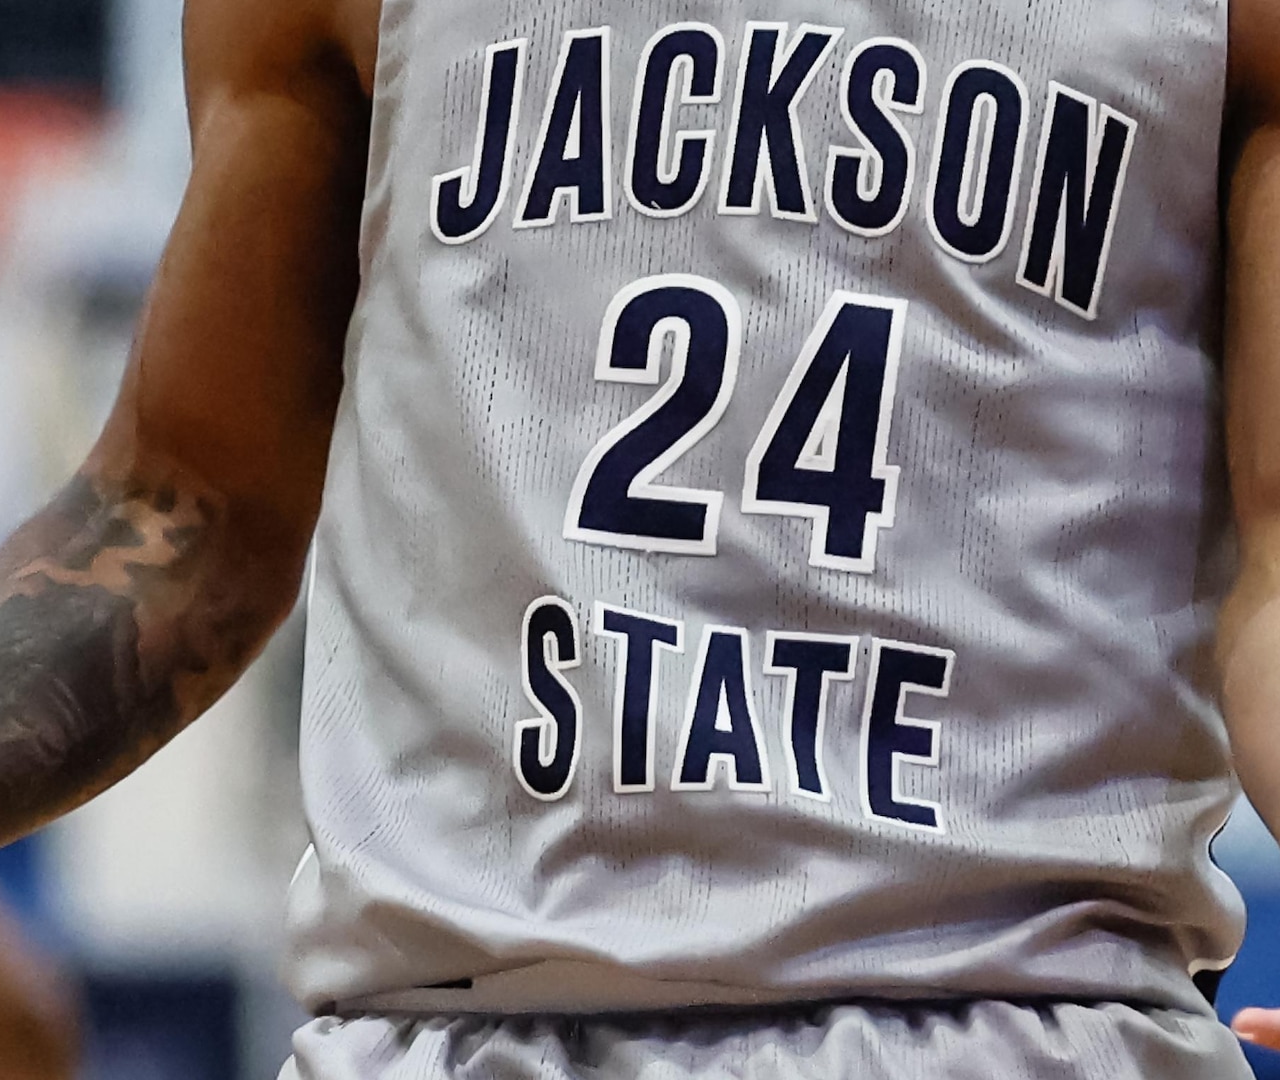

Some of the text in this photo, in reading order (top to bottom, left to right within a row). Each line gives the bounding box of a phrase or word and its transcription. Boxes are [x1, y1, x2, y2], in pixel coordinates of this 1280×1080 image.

[430, 22, 1138, 320] JACKSON
[563, 273, 908, 573] 24
[514, 595, 956, 834] STATE
